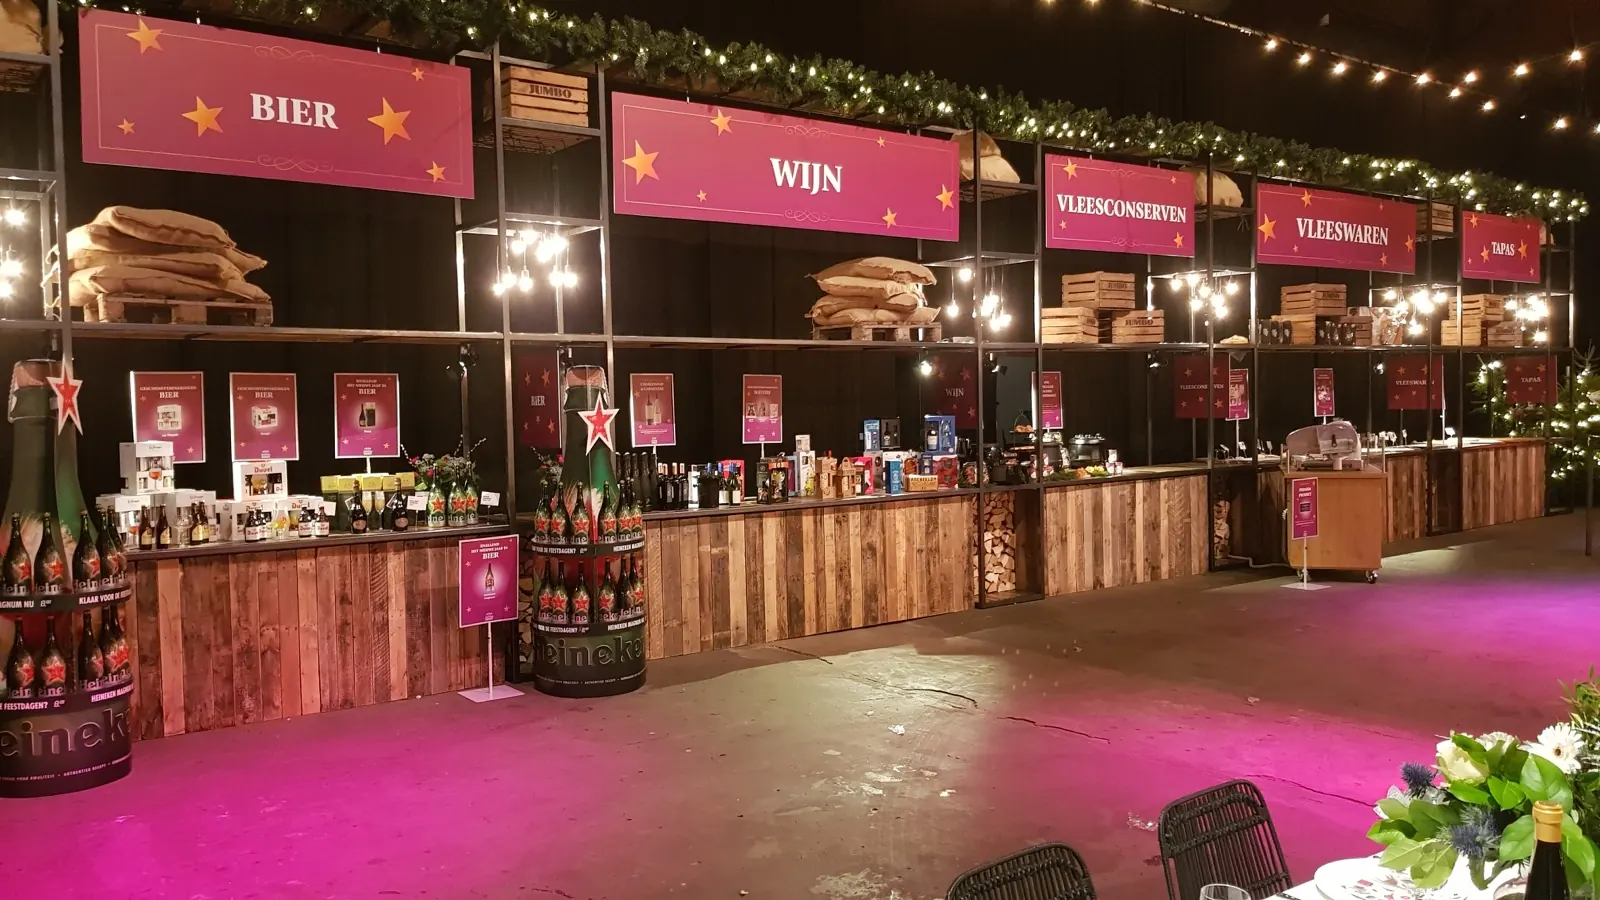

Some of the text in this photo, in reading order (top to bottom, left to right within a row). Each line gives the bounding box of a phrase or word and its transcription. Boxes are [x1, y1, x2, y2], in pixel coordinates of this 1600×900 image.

[529, 84, 572, 99] JUMBO
[250, 93, 339, 130] BIER
[769, 157, 843, 195] WIJN
[1056, 193, 1186, 223] VLEESCONSERVEN
[1297, 217, 1389, 246] VLEESWAREN
[1491, 241, 1515, 257] TAPAS
[159, 391, 180, 399] BIER
[255, 391, 274, 399] BIER
[945, 388, 964, 398] WIJN
[530, 395, 546, 406] BIER
[482, 551, 500, 560] BIER
[0, 600, 22, 609] AGNUM
[24, 600, 35, 608] NU
[79, 596, 99, 605] KLAAR
[100, 593, 114, 602] VOOR
[91, 691, 117, 702] HEINEKEN
[4, 701, 49, 711] FEESTDAGEN?
